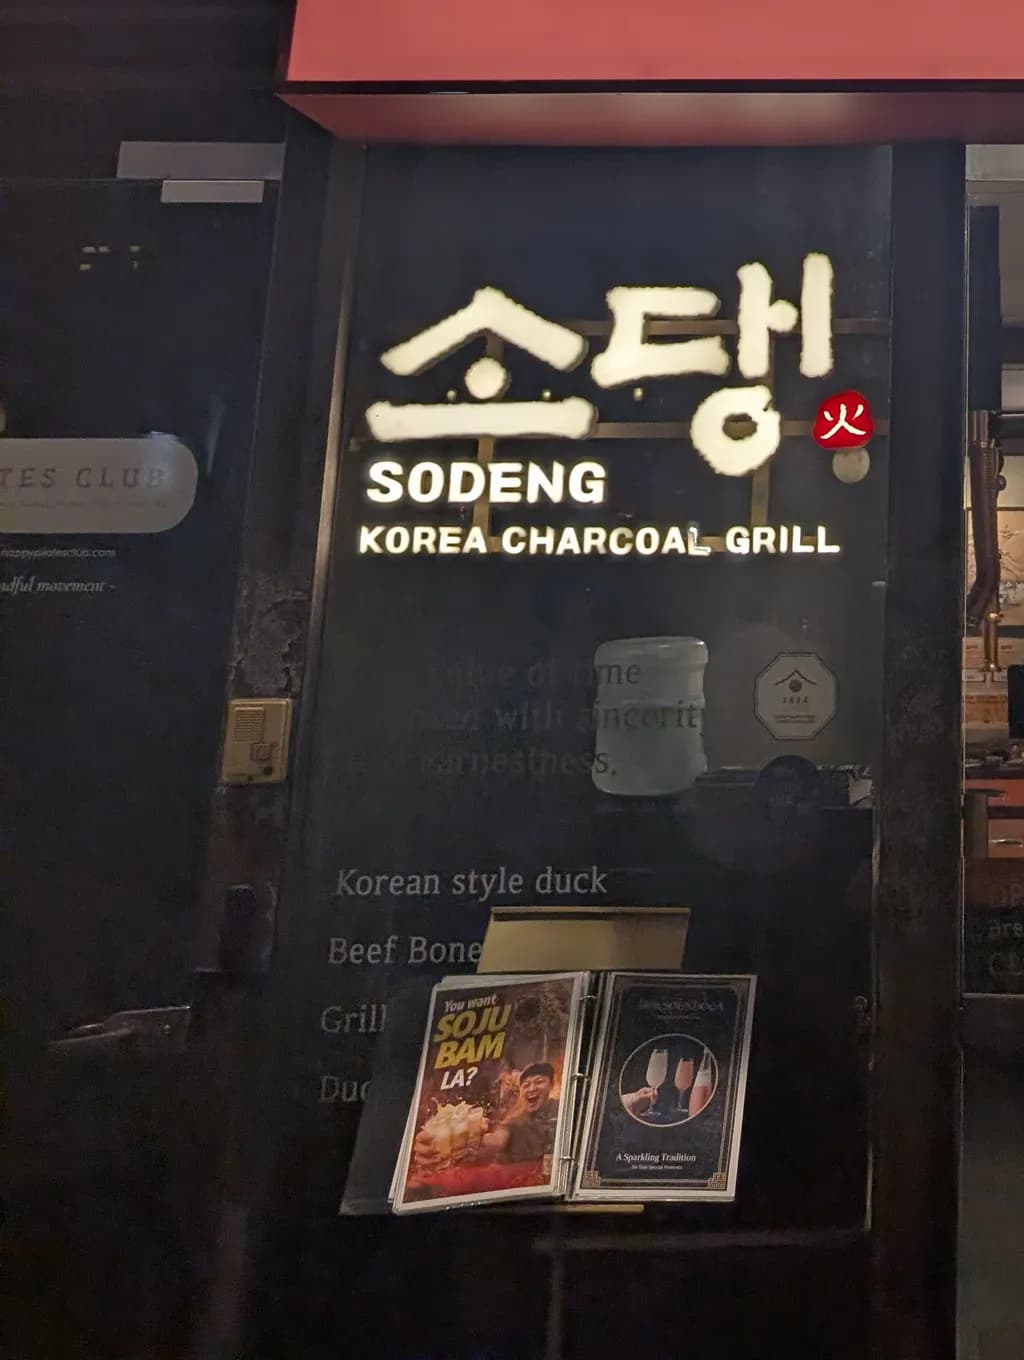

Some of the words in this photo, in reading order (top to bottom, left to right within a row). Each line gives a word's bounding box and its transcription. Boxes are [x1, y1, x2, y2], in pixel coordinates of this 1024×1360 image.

[366, 252, 834, 477] 소댕
[822, 402, 867, 441] 火
[76, 467, 168, 489] CLUB
[366, 461, 607, 504] SODENG
[359, 526, 487, 555] KOREA
[502, 525, 711, 556] CHARCOAL
[725, 526, 840, 554] GRILL
[336, 869, 440, 895] Korean
[452, 871, 523, 902] style
[535, 865, 608, 894] duck
[327, 935, 398, 964] Beef
[407, 936, 482, 964] Bone
[444, 999, 466, 1013] You
[467, 994, 497, 1008] want
[435, 1004, 512, 1043] SOJU
[434, 1032, 505, 1069] BAM
[440, 1066, 479, 1090] LA?
[615, 1153, 622, 1161] A
[623, 1152, 660, 1163] Sparkling
[662, 1152, 697, 1162] Tradition
